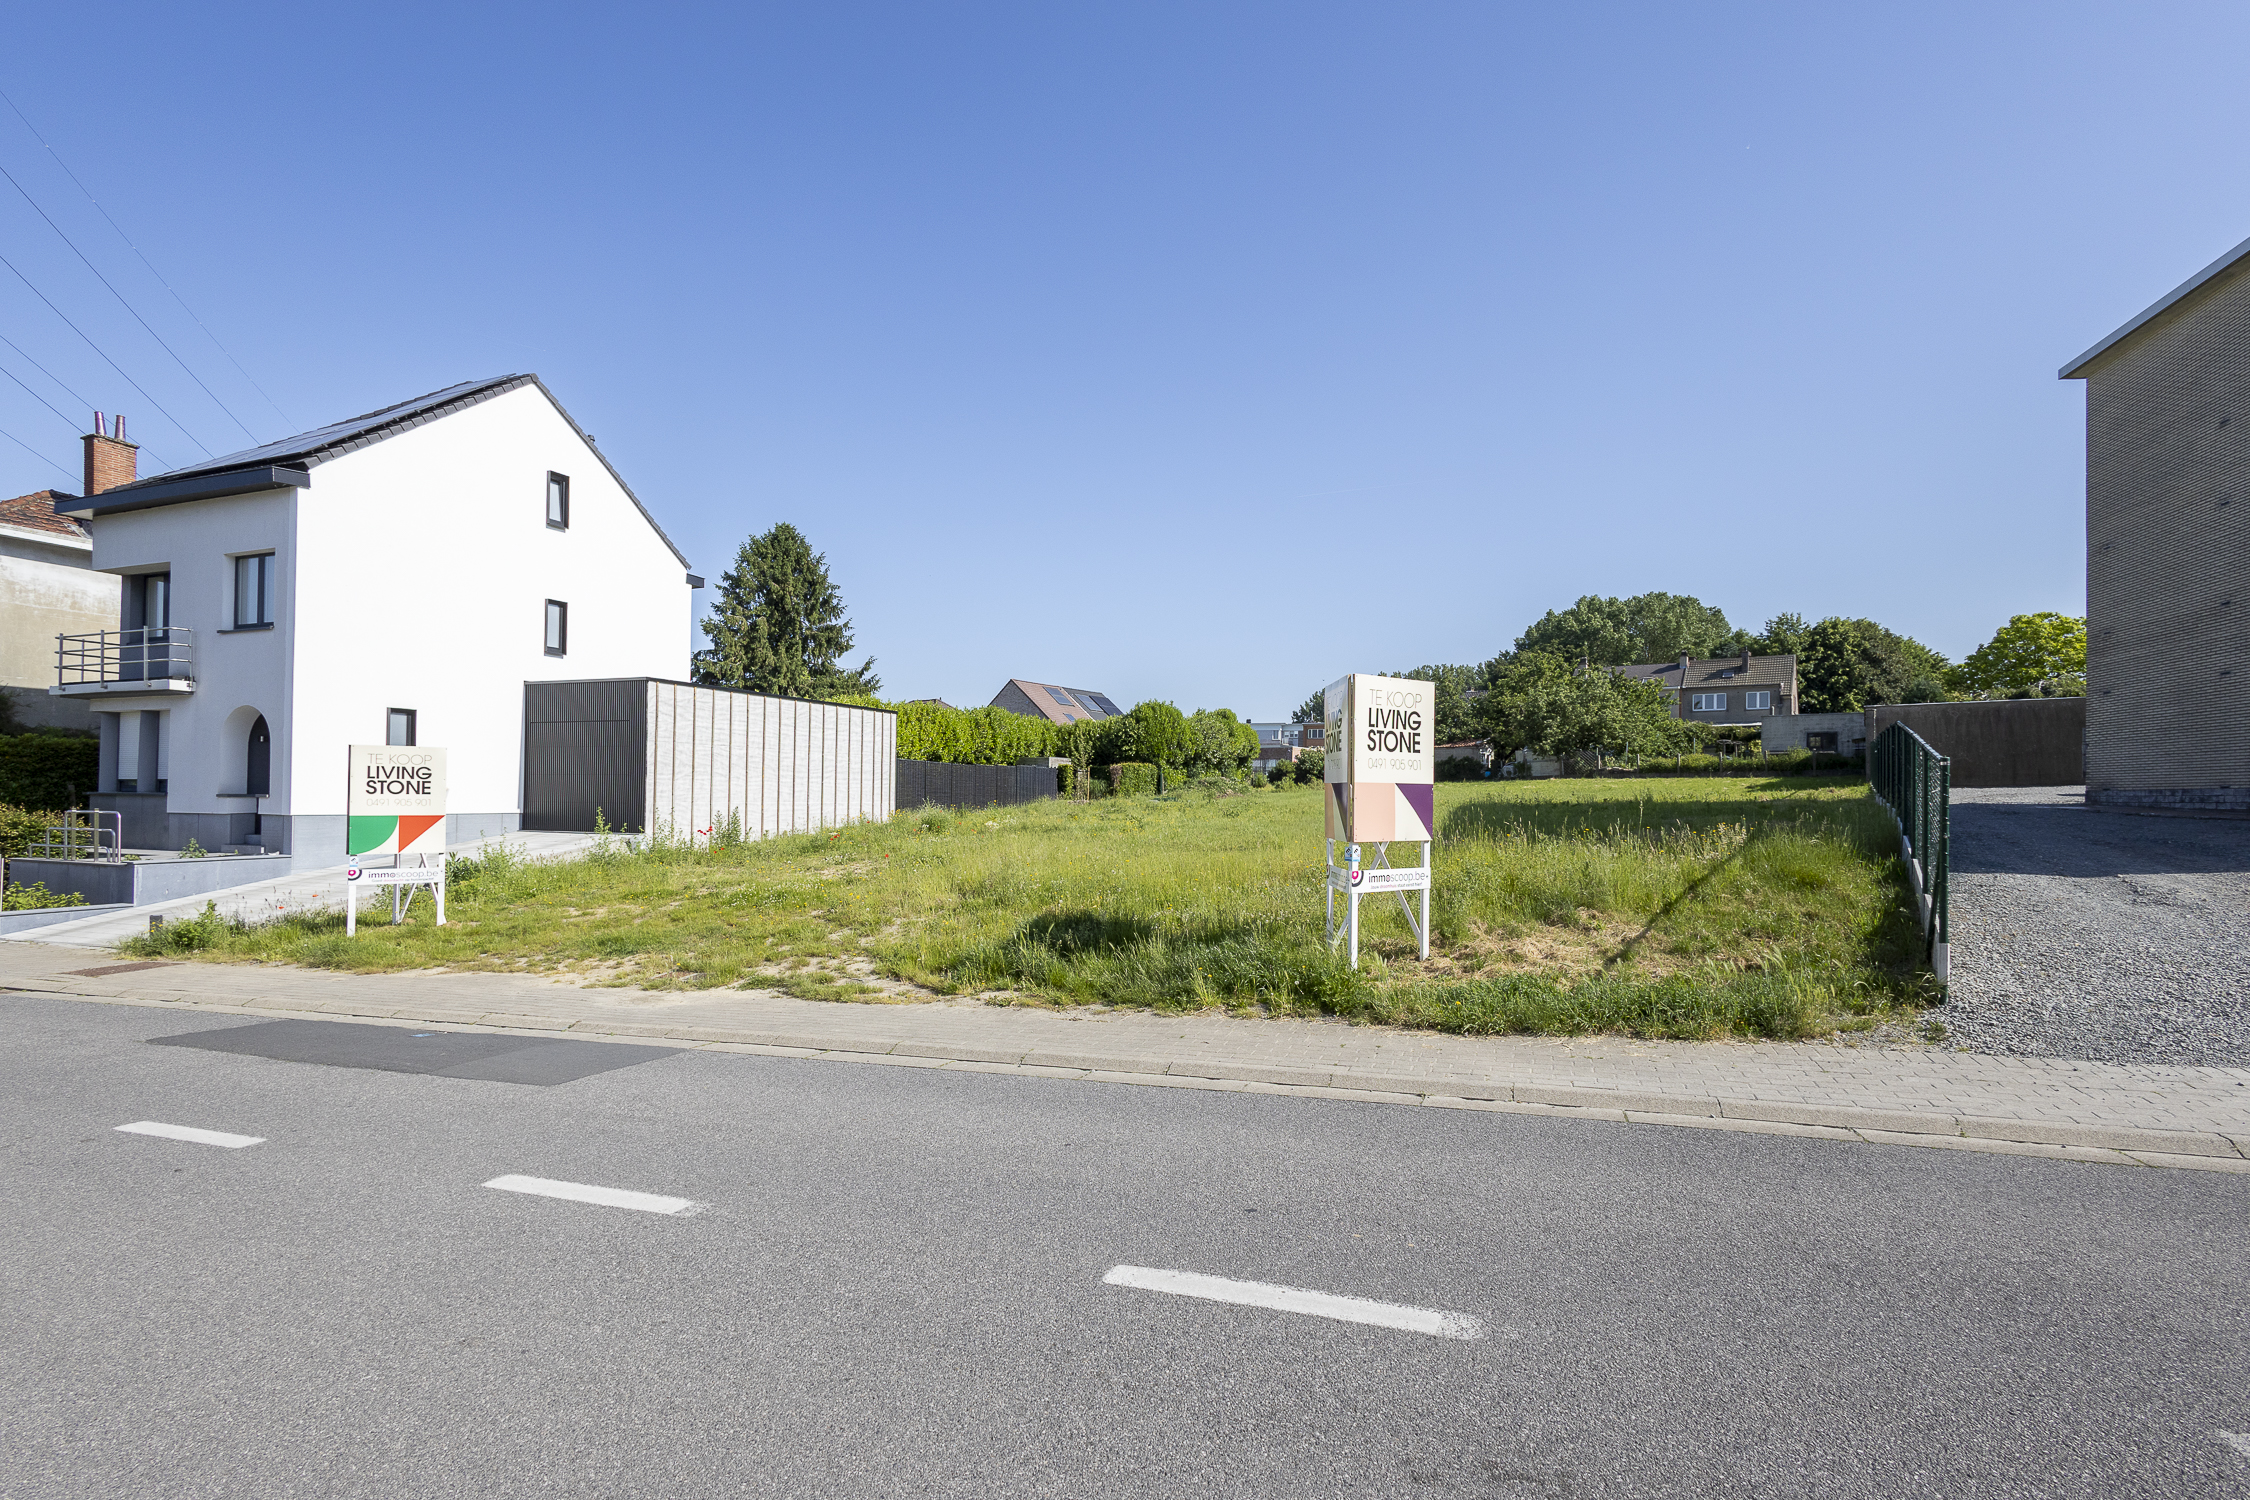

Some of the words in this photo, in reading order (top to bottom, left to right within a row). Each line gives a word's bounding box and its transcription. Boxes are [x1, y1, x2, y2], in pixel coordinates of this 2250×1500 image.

[1369, 688, 1382, 706] TE
[1386, 691, 1422, 709] KOOP
[1368, 707, 1421, 731] LIVING
[1367, 729, 1421, 753] STONE
[367, 753, 383, 764] TE
[389, 753, 433, 766] KOOP
[1367, 757, 1387, 769] 0491
[1390, 758, 1406, 771] 905
[1408, 759, 1422, 771] 901
[367, 765, 432, 780] LIVING
[365, 779, 431, 795] STONE
[366, 798, 390, 807] 0491
[394, 798, 412, 807] 905
[414, 798, 432, 807] 901
[368, 870, 439, 879] immoscoop.be
[1368, 871, 1426, 883] immoscoop.be
